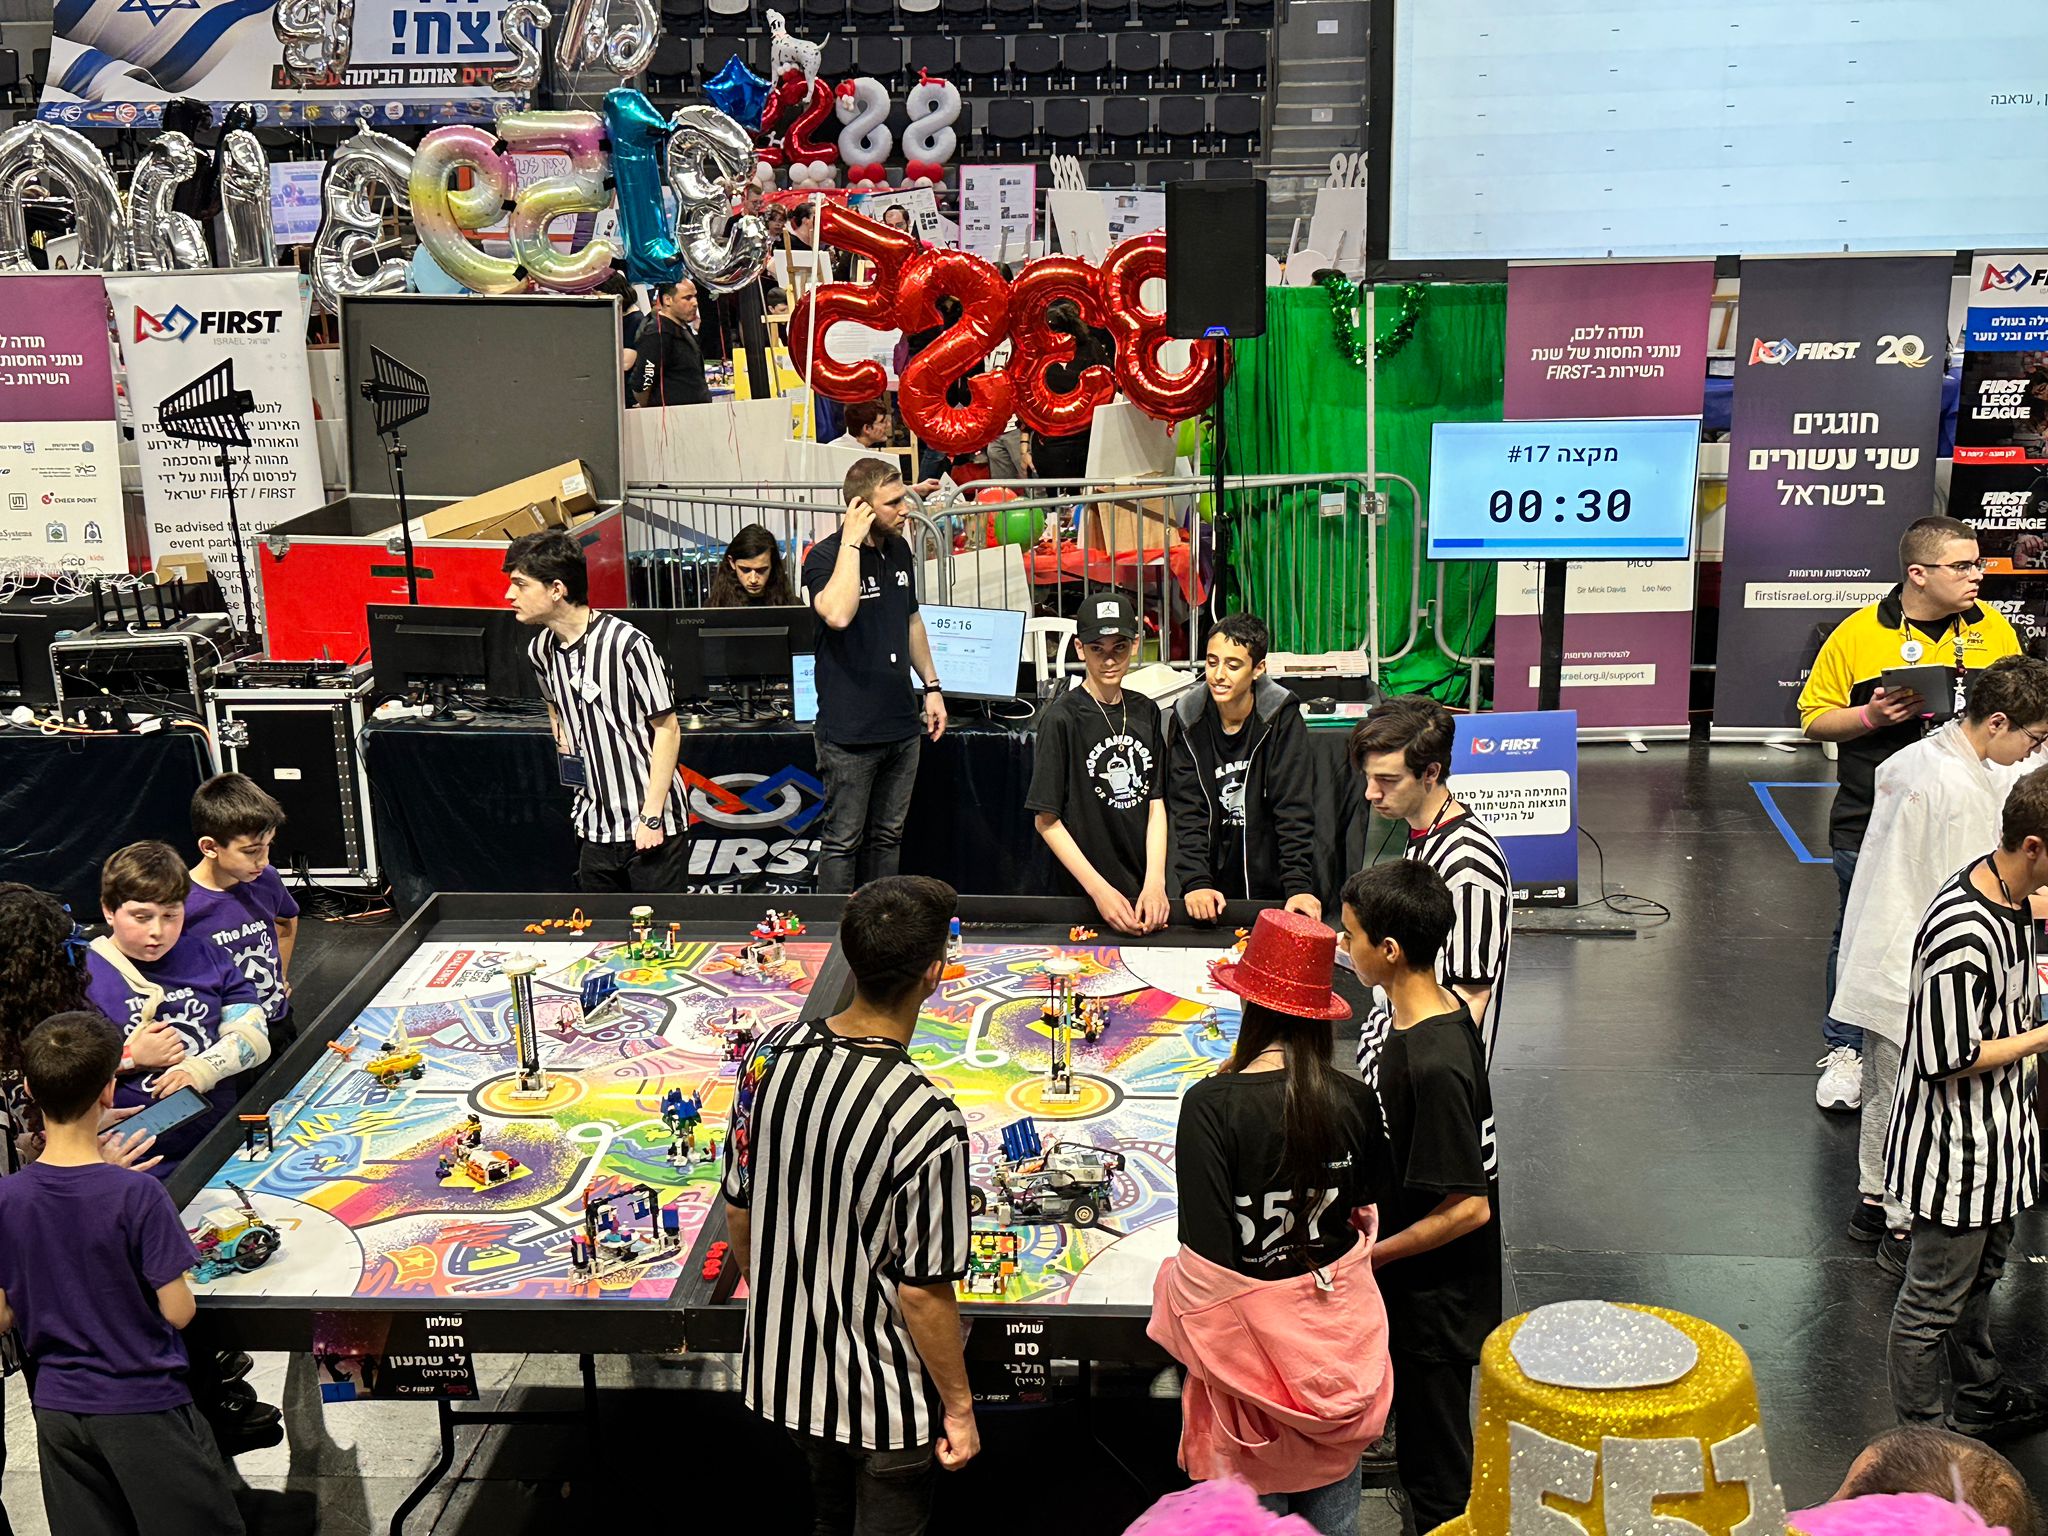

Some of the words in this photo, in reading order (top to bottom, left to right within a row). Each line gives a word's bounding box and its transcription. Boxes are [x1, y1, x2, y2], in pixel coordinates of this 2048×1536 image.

[1990, 93, 2033, 105] עראבה
[200, 311, 282, 334] FIRST
[1991, 315, 2026, 327] בעולם
[1569, 325, 1605, 343] לכם,
[1607, 326, 1643, 339] תודה
[1973, 331, 1998, 341] נוער
[2001, 332, 2021, 341] ובני
[11, 335, 45, 348] תודה
[213, 338, 244, 346] ISRAEL
[1531, 347, 1564, 361] שנת
[1567, 344, 1592, 359] של
[1594, 347, 1643, 359] החסות
[1647, 344, 1681, 358] נותני
[1795, 341, 1861, 360] FIRST
[1875, 334, 1926, 365] 20
[50, 354, 83, 367] נותני
[1608, 364, 1665, 379] השירות
[17, 371, 70, 386] השירות
[1979, 380, 2030, 394] FIRST
[1981, 394, 2023, 406] LEGO
[1972, 407, 2031, 420] LEAGUE
[258, 420, 300, 431] האירוע
[1792, 411, 1879, 435] חוגגים
[162, 456, 212, 468] והסכמה
[255, 455, 289, 466] מהווה
[1557, 446, 1618, 466] מקצה
[1748, 448, 1857, 471] עשורים
[1865, 448, 1919, 471] שני
[158, 472, 176, 484] ידי
[180, 472, 196, 483] על
[253, 470, 297, 482] לפרסום
[165, 489, 206, 501] ישראל
[210, 488, 248, 499] FIRST
[259, 487, 296, 499] FIRST
[1776, 480, 1886, 507] בישראל
[1981, 491, 2032, 505] FIRST
[1489, 489, 1631, 523] 00:30
[1983, 505, 2023, 517] TECH
[154, 522, 172, 534] Be
[175, 521, 224, 532] advised
[1961, 518, 2047, 530] CHALLENGE
[169, 537, 206, 548] event
[208, 552, 229, 563] will
[1788, 568, 1824, 578] ותרומות
[1825, 567, 1871, 578] להצטרפות
[375, 612, 404, 620] Lenovo
[675, 617, 706, 625] Lenovo
[1104, 735, 1134, 749] AND
[1500, 737, 1541, 751] FIRST
[1479, 789, 1494, 799] על
[1497, 788, 1521, 798] הינה
[1524, 786, 1567, 798] החתימה
[1474, 800, 1525, 812] המשימות
[1528, 798, 1567, 808] תוצאות
[1481, 811, 1518, 824] הניקוד
[1521, 810, 1535, 821] על
[688, 838, 822, 876] IRS
[212, 928, 241, 946] The
[241, 918, 268, 937] Aces
[425, 1315, 463, 1329] שולחן
[1006, 1322, 1044, 1336] שולחן
[428, 1334, 464, 1348] רונה
[1014, 1342, 1039, 1356] סם
[388, 1355, 443, 1369] שמעון
[448, 1353, 466, 1366] לי
[421, 1368, 469, 1379] (רקדנית)
[1003, 1361, 1045, 1374] חלבי
[1014, 1376, 1046, 1387] (צייר)
